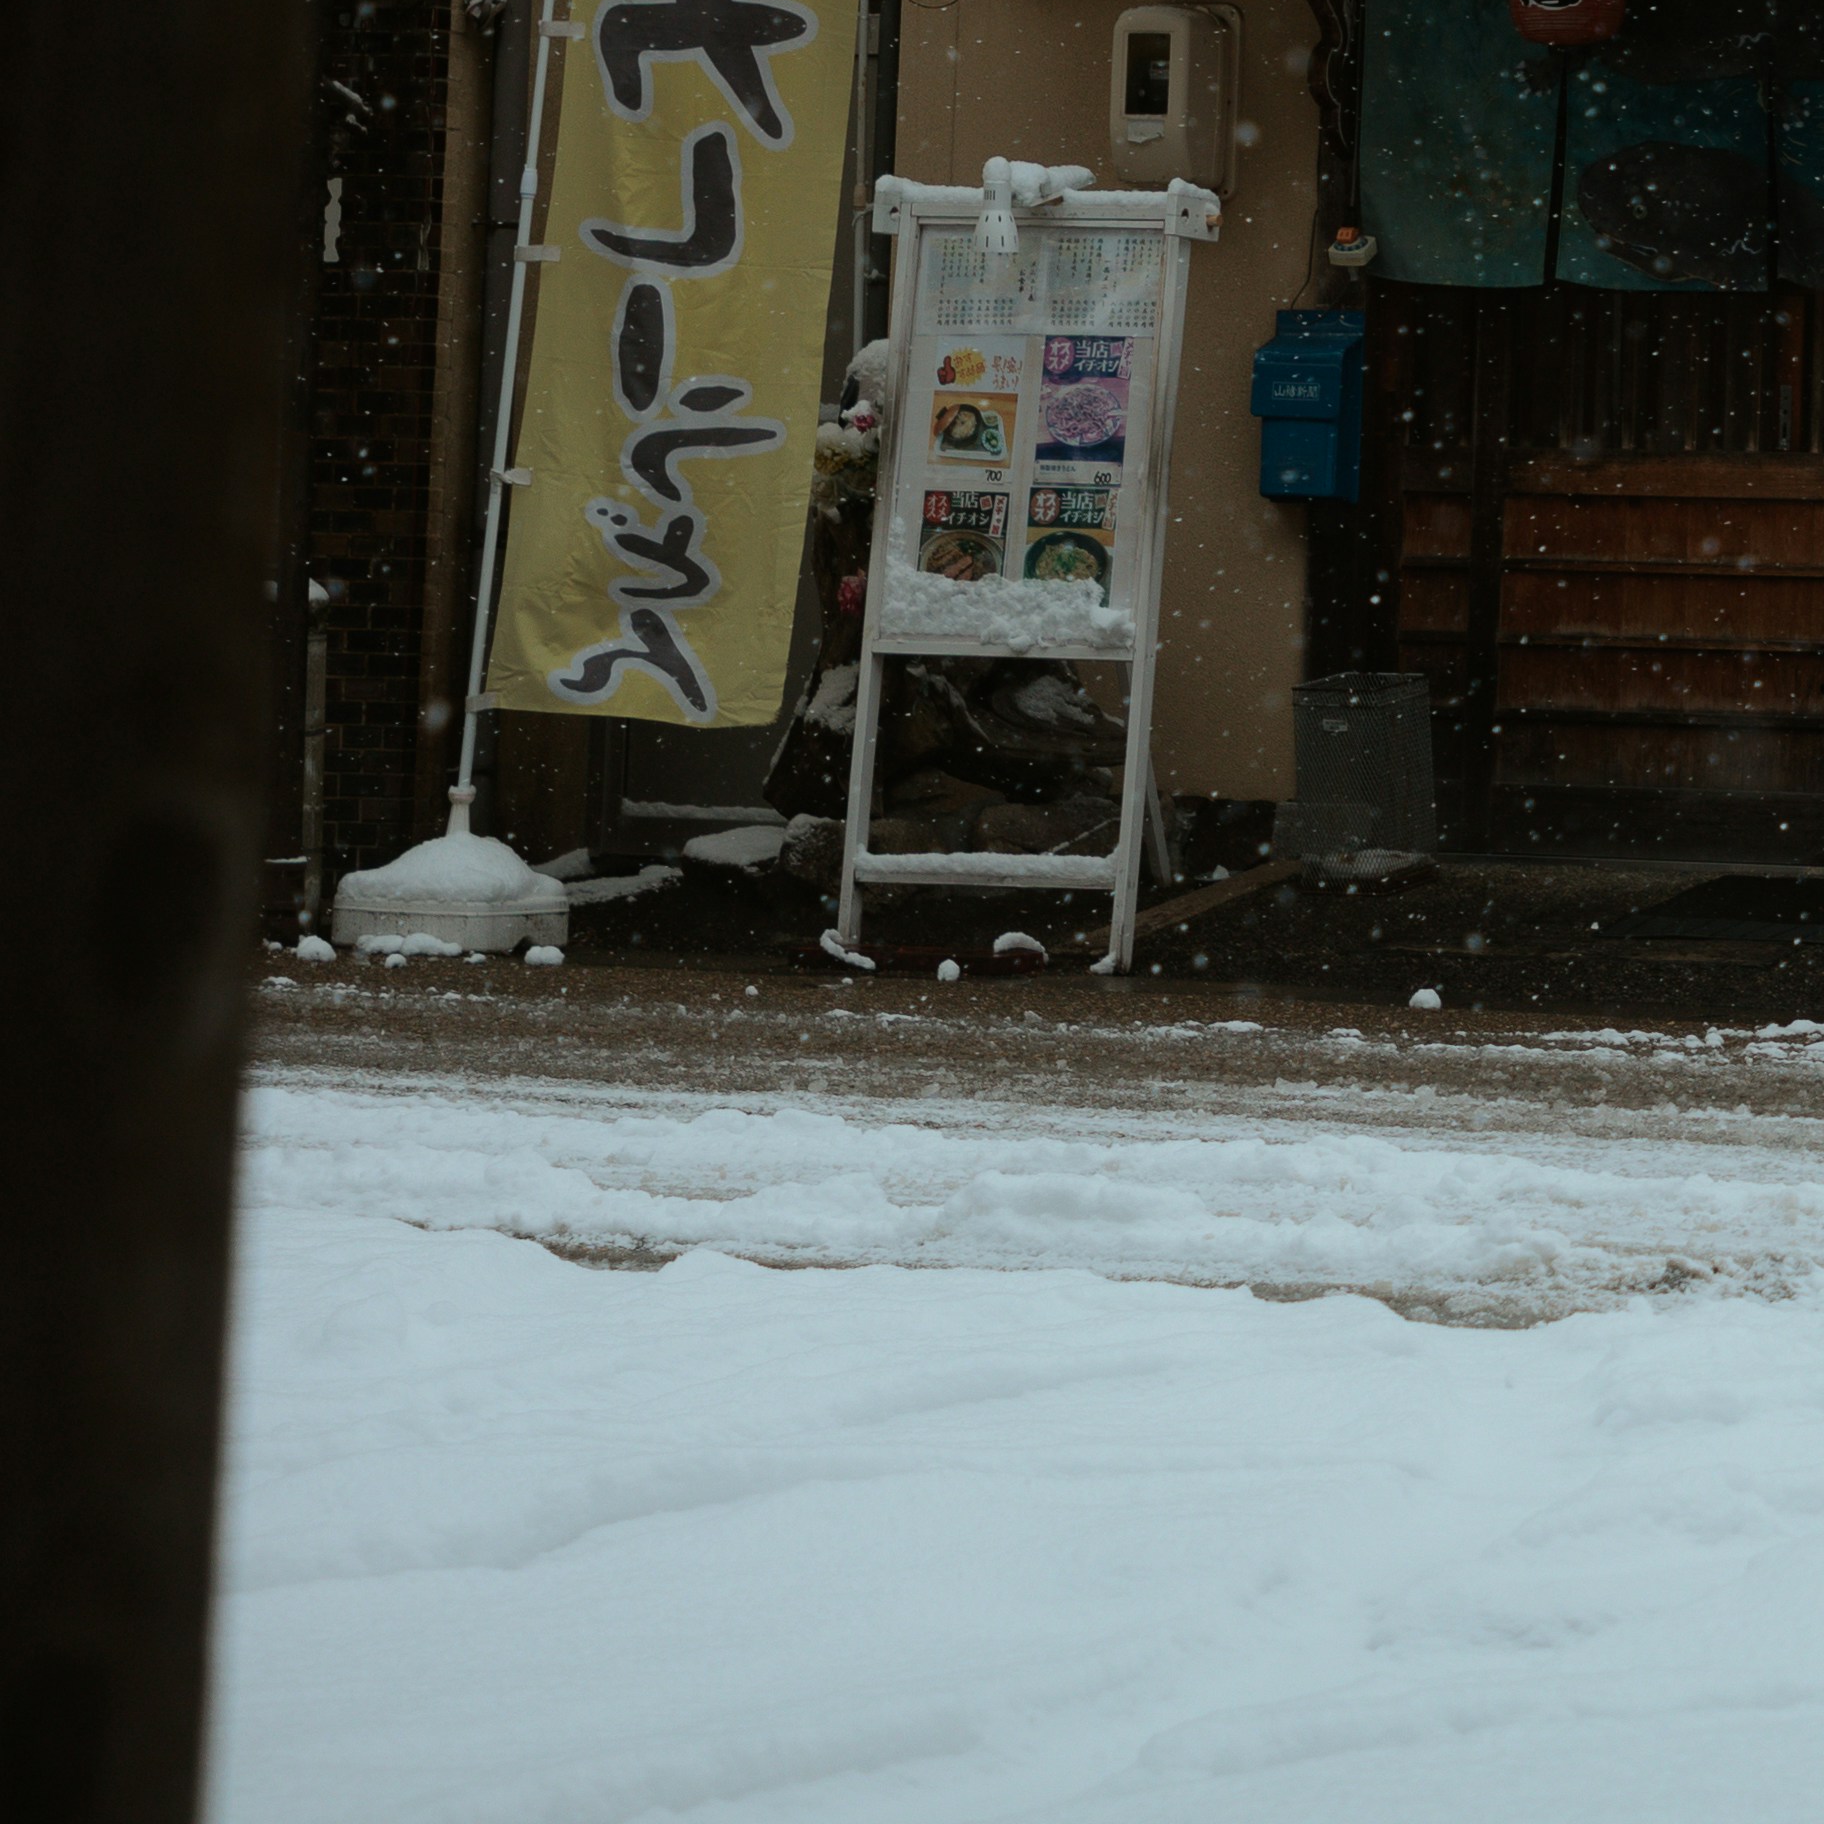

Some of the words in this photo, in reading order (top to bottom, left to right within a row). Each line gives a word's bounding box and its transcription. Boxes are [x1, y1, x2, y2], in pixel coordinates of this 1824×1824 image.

[1075, 340, 1110, 359] 当店
[1074, 359, 1120, 373] イチオシ
[985, 469, 1003, 482] 700
[951, 491, 979, 509] 当店
[1060, 492, 1093, 510] 当店
[947, 512, 990, 526] イチオシ
[1060, 511, 1104, 524] イチオシ
